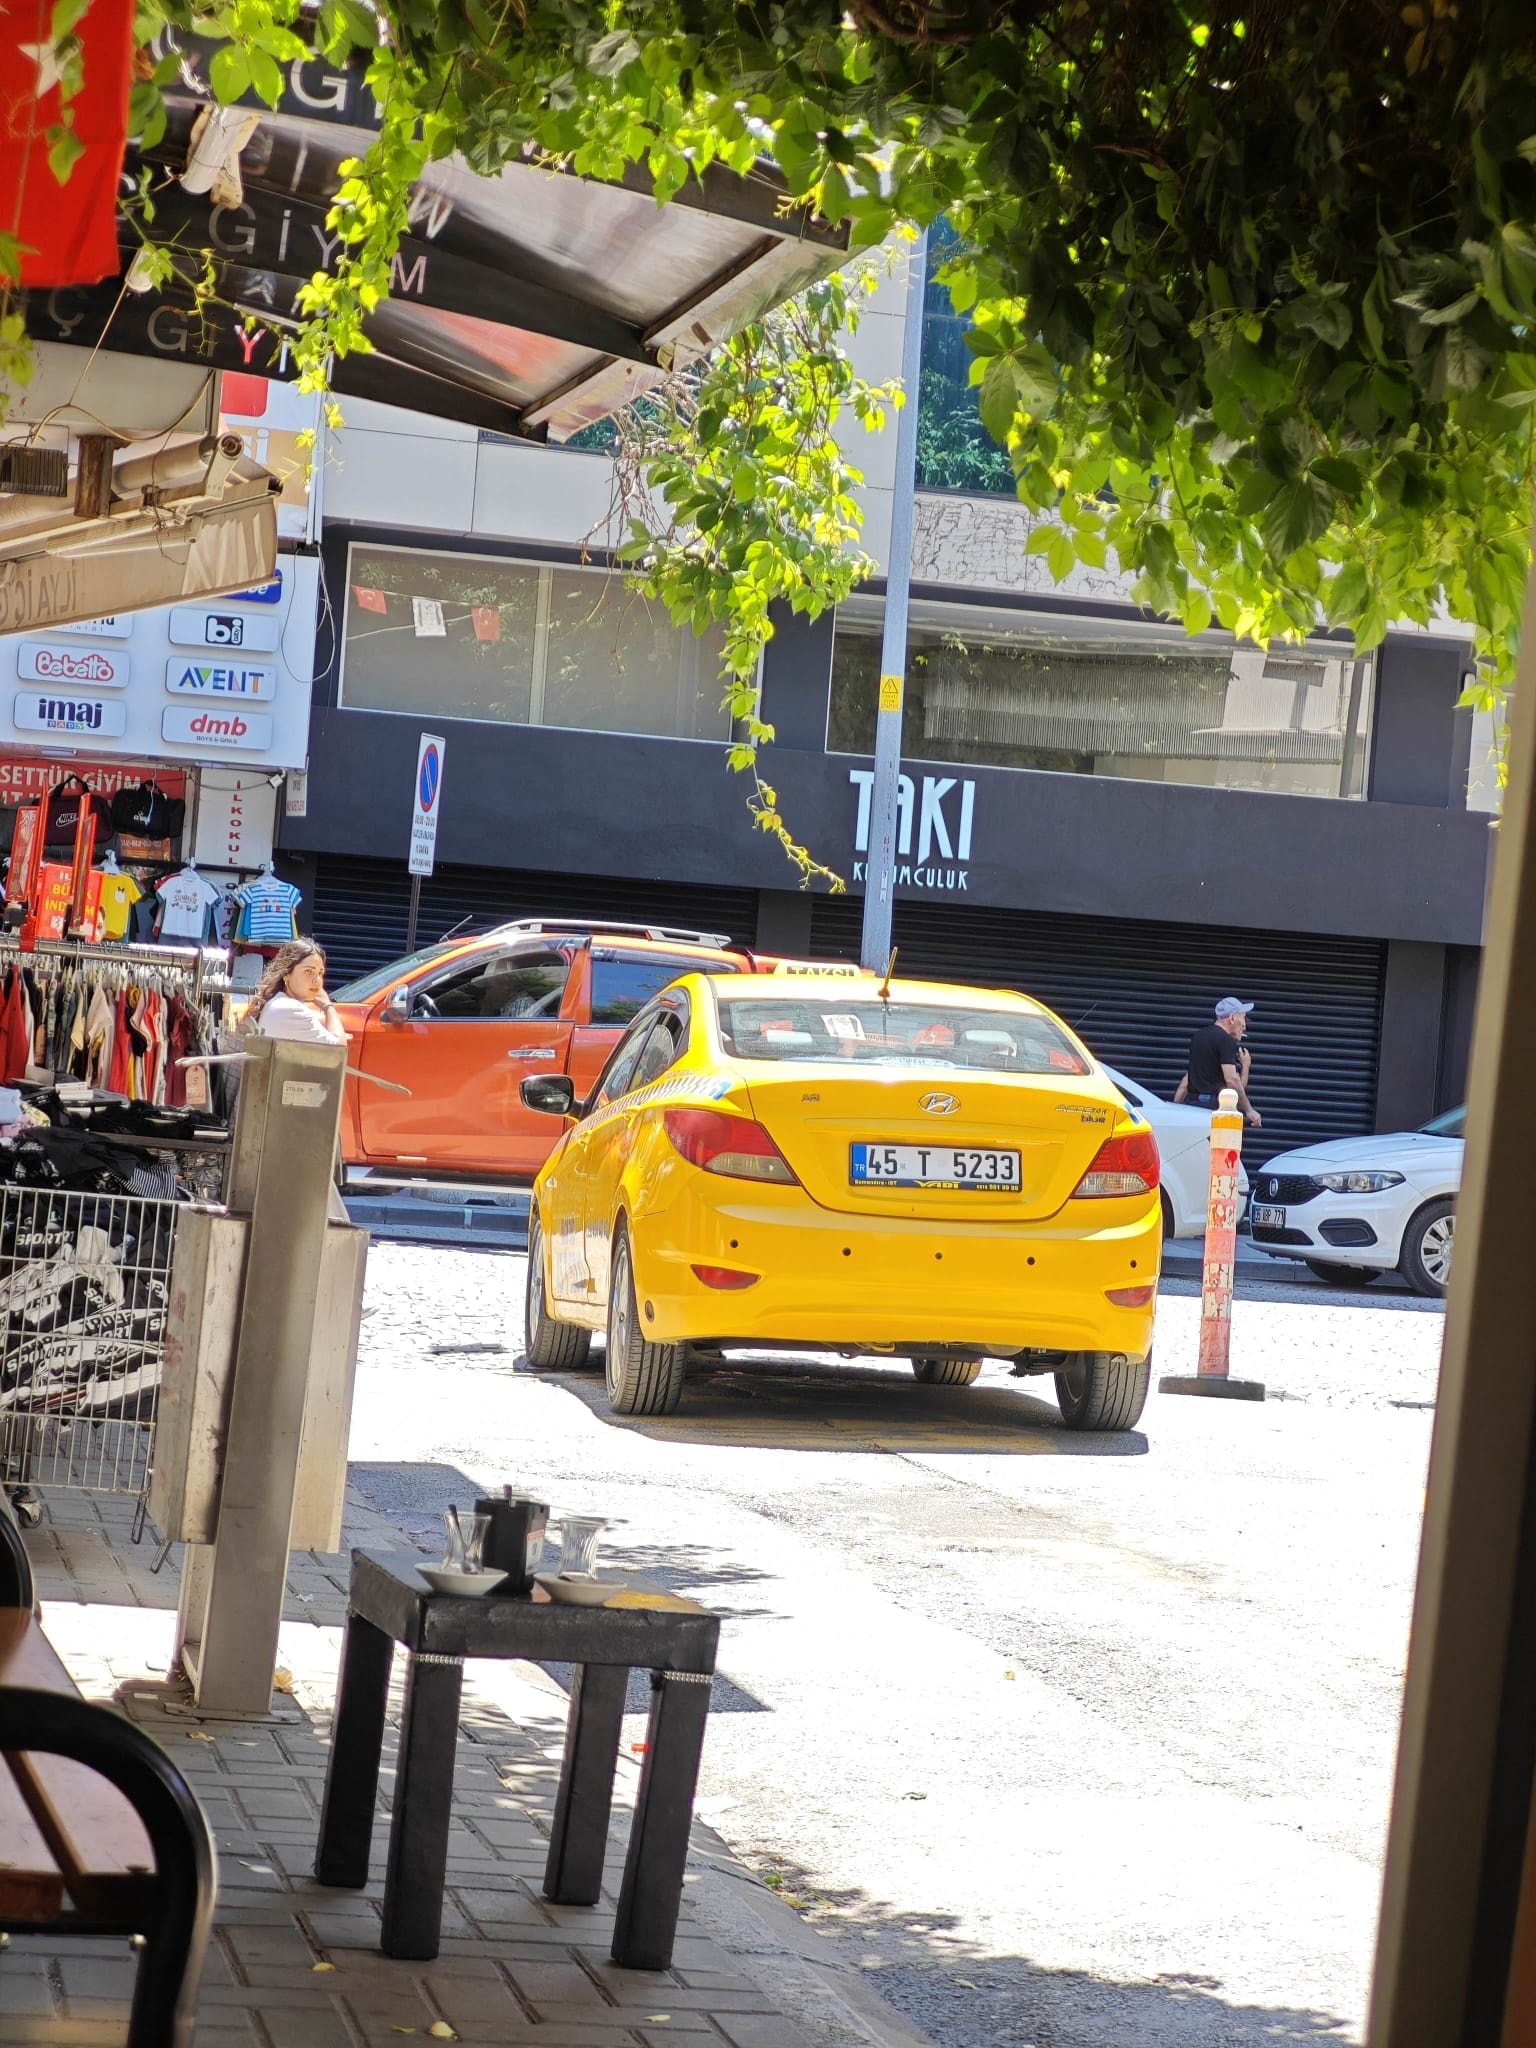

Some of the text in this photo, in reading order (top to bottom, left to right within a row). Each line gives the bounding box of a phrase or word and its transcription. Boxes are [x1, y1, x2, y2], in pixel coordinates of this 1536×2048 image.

[208, 203, 428, 295] GİYM
[207, 617, 242, 644] bi
[36, 651, 114, 681] Bebetto
[178, 667, 264, 694] AVENT
[39, 698, 103, 729] imaj
[190, 713, 247, 736] dmb
[60, 813, 77, 823] NIKE
[849, 769, 976, 866] TAKI
[1081, 1115, 1106, 1124] blue
[854, 1163, 866, 1173] TR
[868, 1148, 1014, 1181] 45 T 5233
